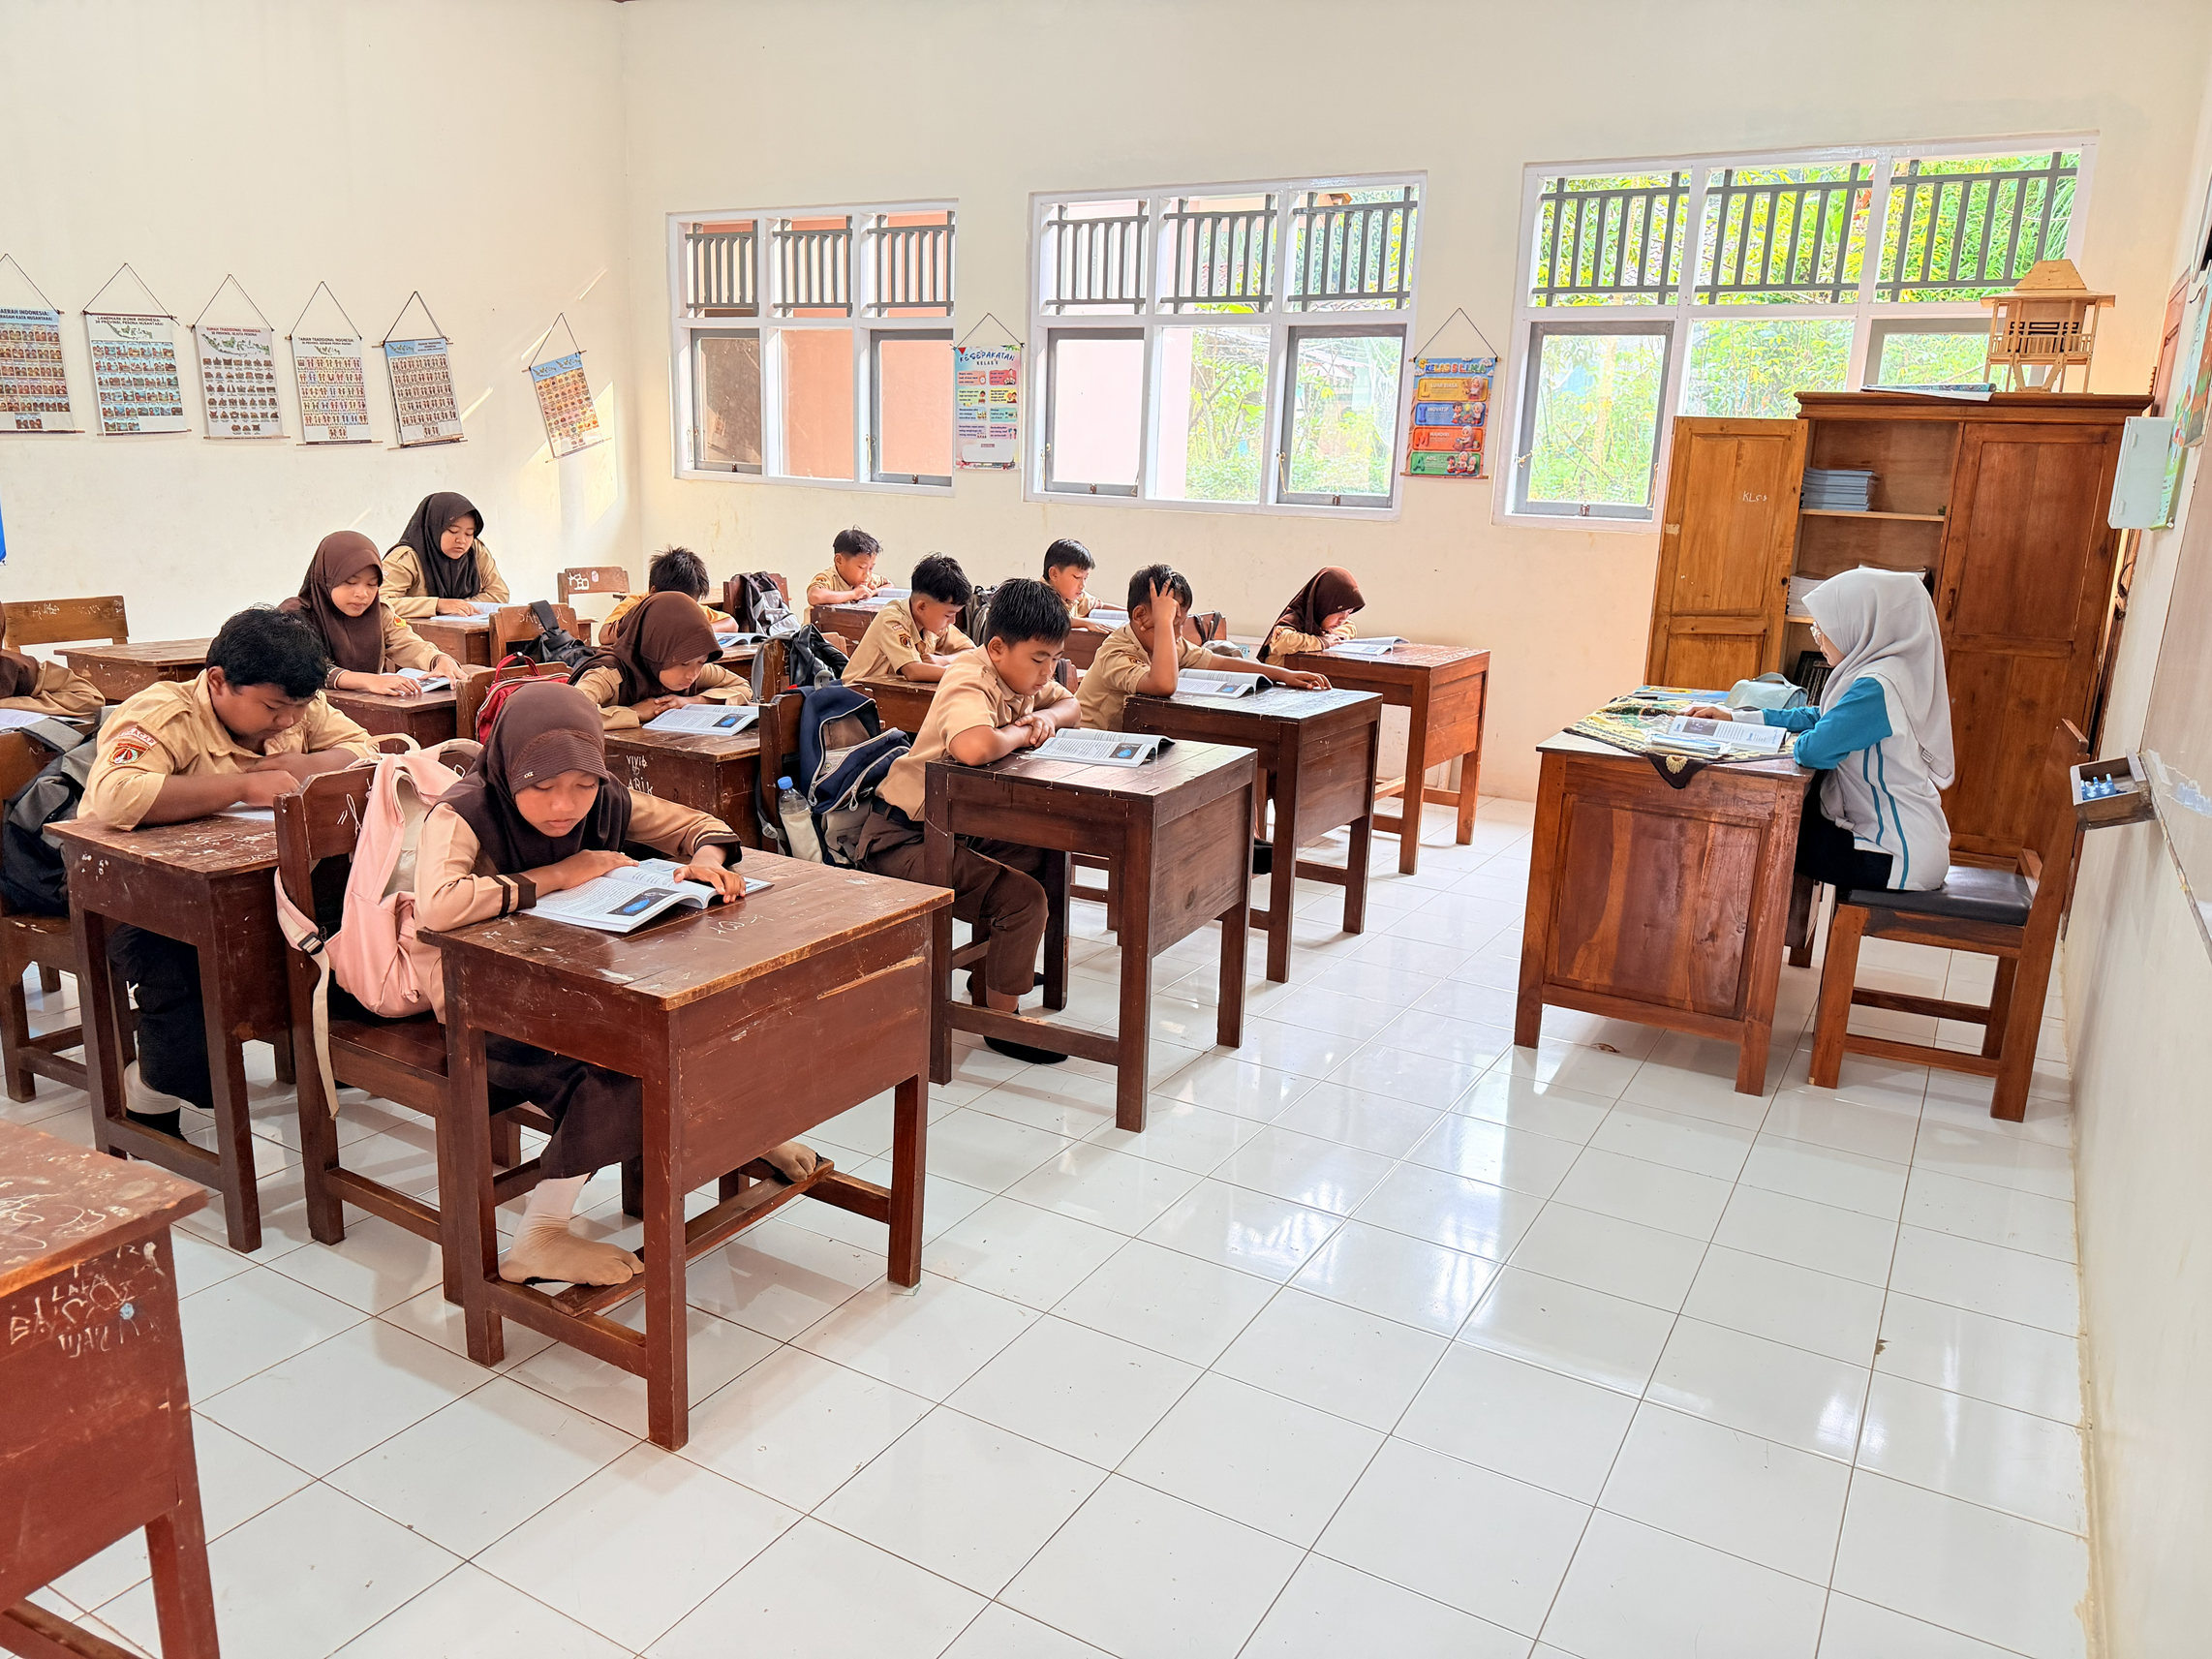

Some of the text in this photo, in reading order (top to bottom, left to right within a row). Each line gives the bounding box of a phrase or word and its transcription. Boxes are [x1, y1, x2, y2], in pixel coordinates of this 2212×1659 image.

[960, 351, 1015, 362] KESEPAKATAN
[1425, 363, 1486, 374] KELAS 5 LIMA
